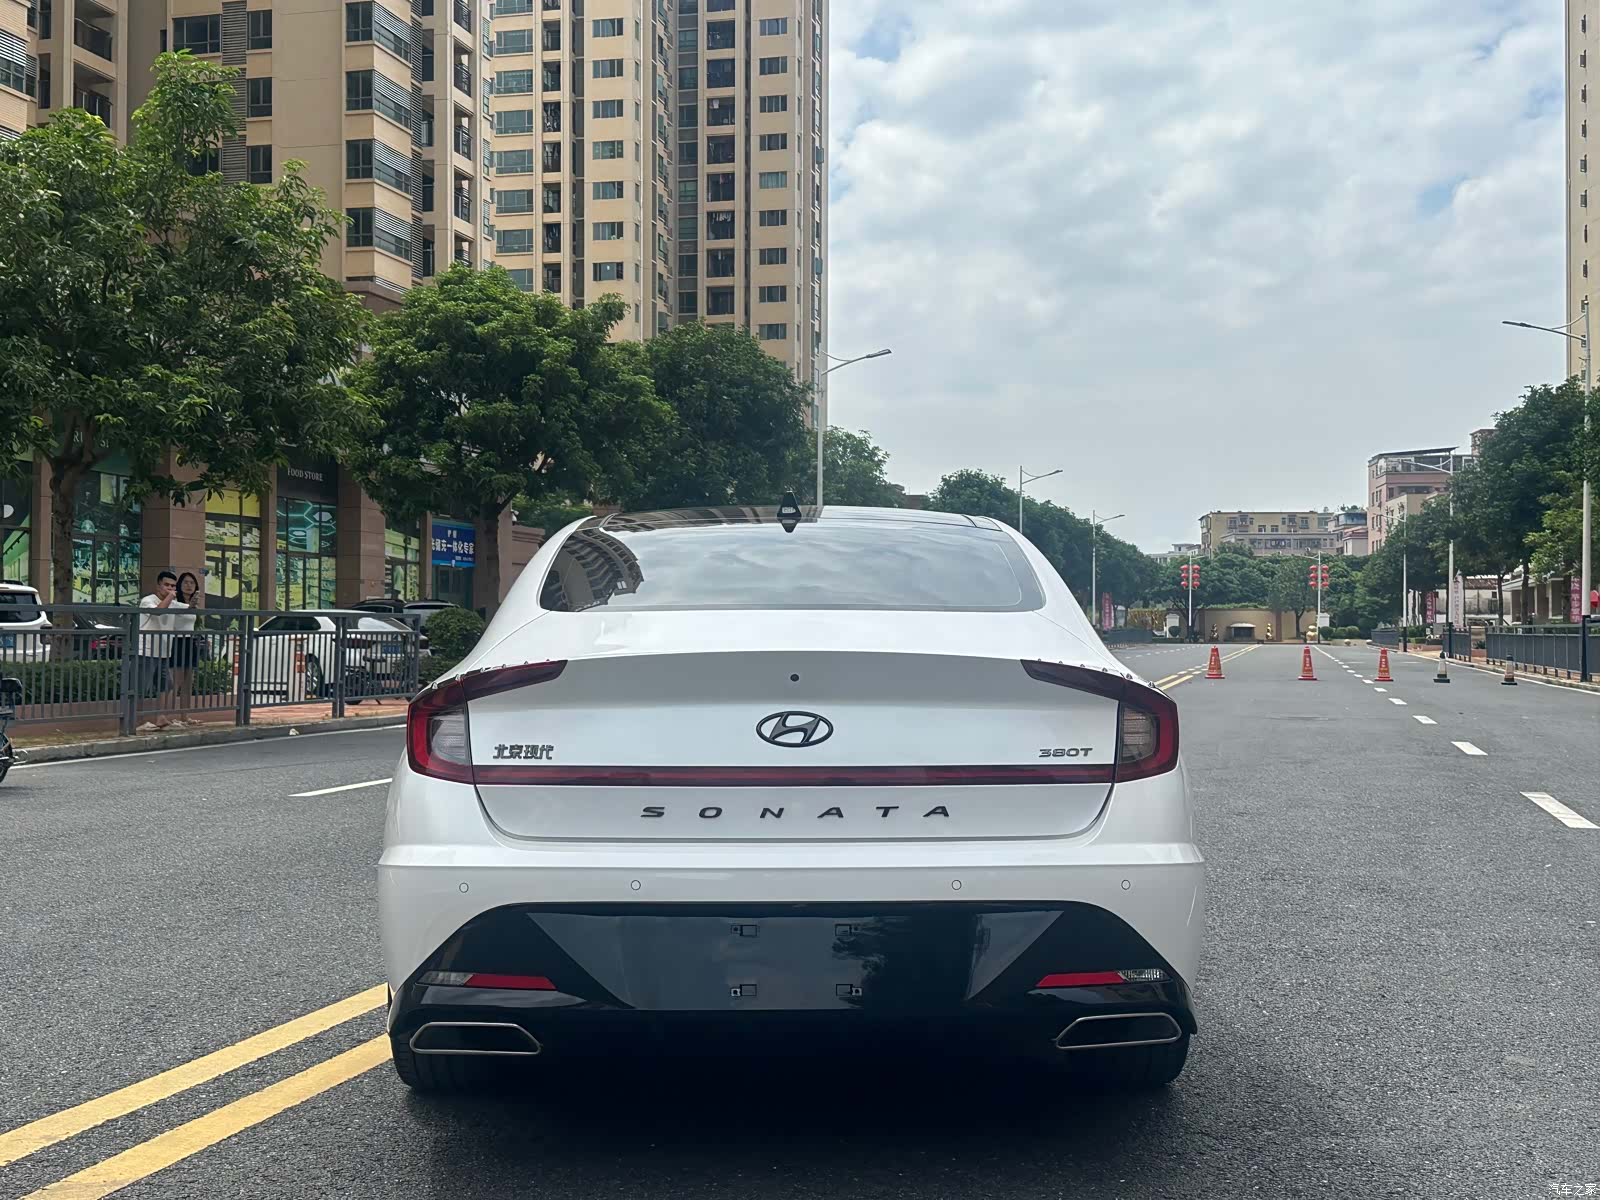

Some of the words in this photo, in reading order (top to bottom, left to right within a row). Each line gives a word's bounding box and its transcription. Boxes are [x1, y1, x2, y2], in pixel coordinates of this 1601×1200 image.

[287, 467, 304, 478] FOOD
[304, 470, 324, 482] STORE
[493, 744, 554, 760] 北京现代
[1038, 747, 1093, 758] 380T
[640, 805, 951, 819] SONATA
